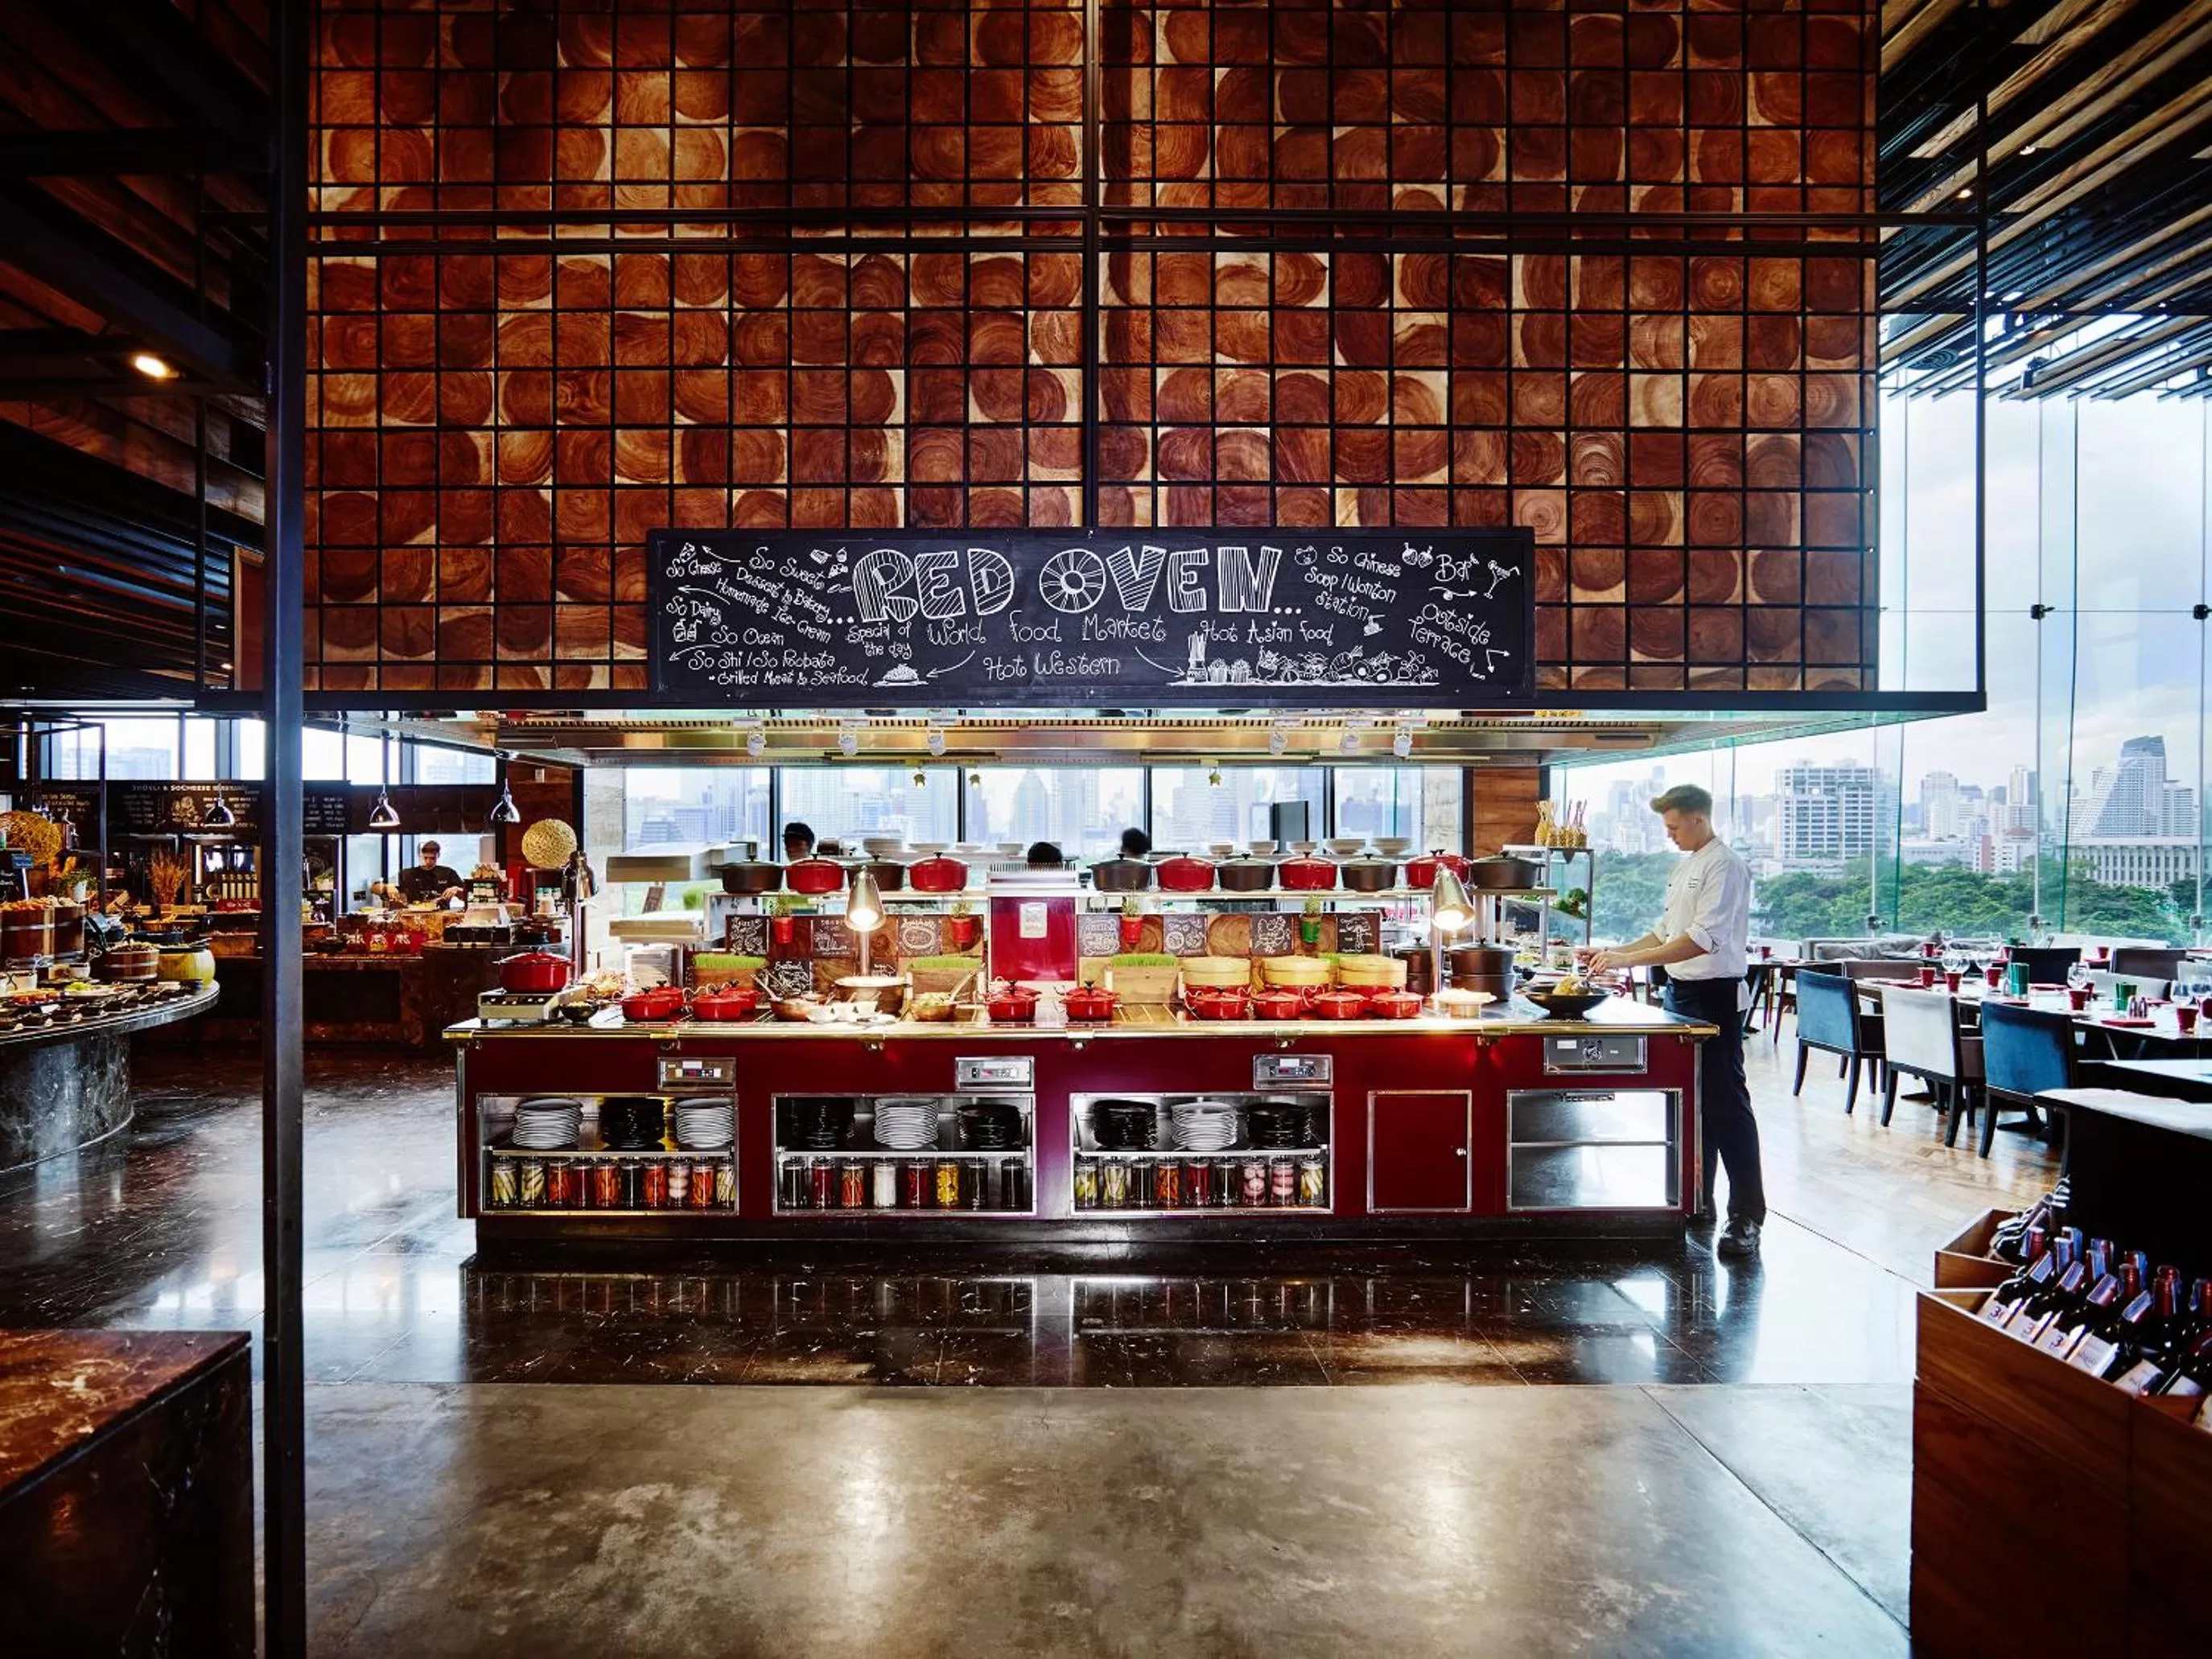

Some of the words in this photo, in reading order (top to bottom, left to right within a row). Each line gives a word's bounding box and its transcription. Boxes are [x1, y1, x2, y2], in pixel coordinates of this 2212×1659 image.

[666, 558, 685, 578] So
[688, 561, 722, 576] Cheese
[749, 546, 775, 570] So
[1327, 546, 1349, 566] So
[1353, 553, 1401, 578] Chinese
[1435, 554, 1472, 582] Bar
[666, 596, 686, 615] So
[692, 601, 722, 626] Dairy
[711, 625, 738, 644] So
[743, 628, 785, 646] Ocean
[898, 621, 912, 638] of
[928, 618, 987, 645] World
[1082, 613, 1167, 642] Market
[1200, 619, 1238, 644] Hot
[1247, 619, 1293, 644] Asian
[688, 650, 715, 670] So
[863, 642, 884, 657] the
[888, 644, 912, 660] day
[718, 669, 758, 685] Grilled
[763, 671, 794, 685] Meat
[983, 654, 1027, 681] Hot
[1033, 649, 1121, 677] Western
